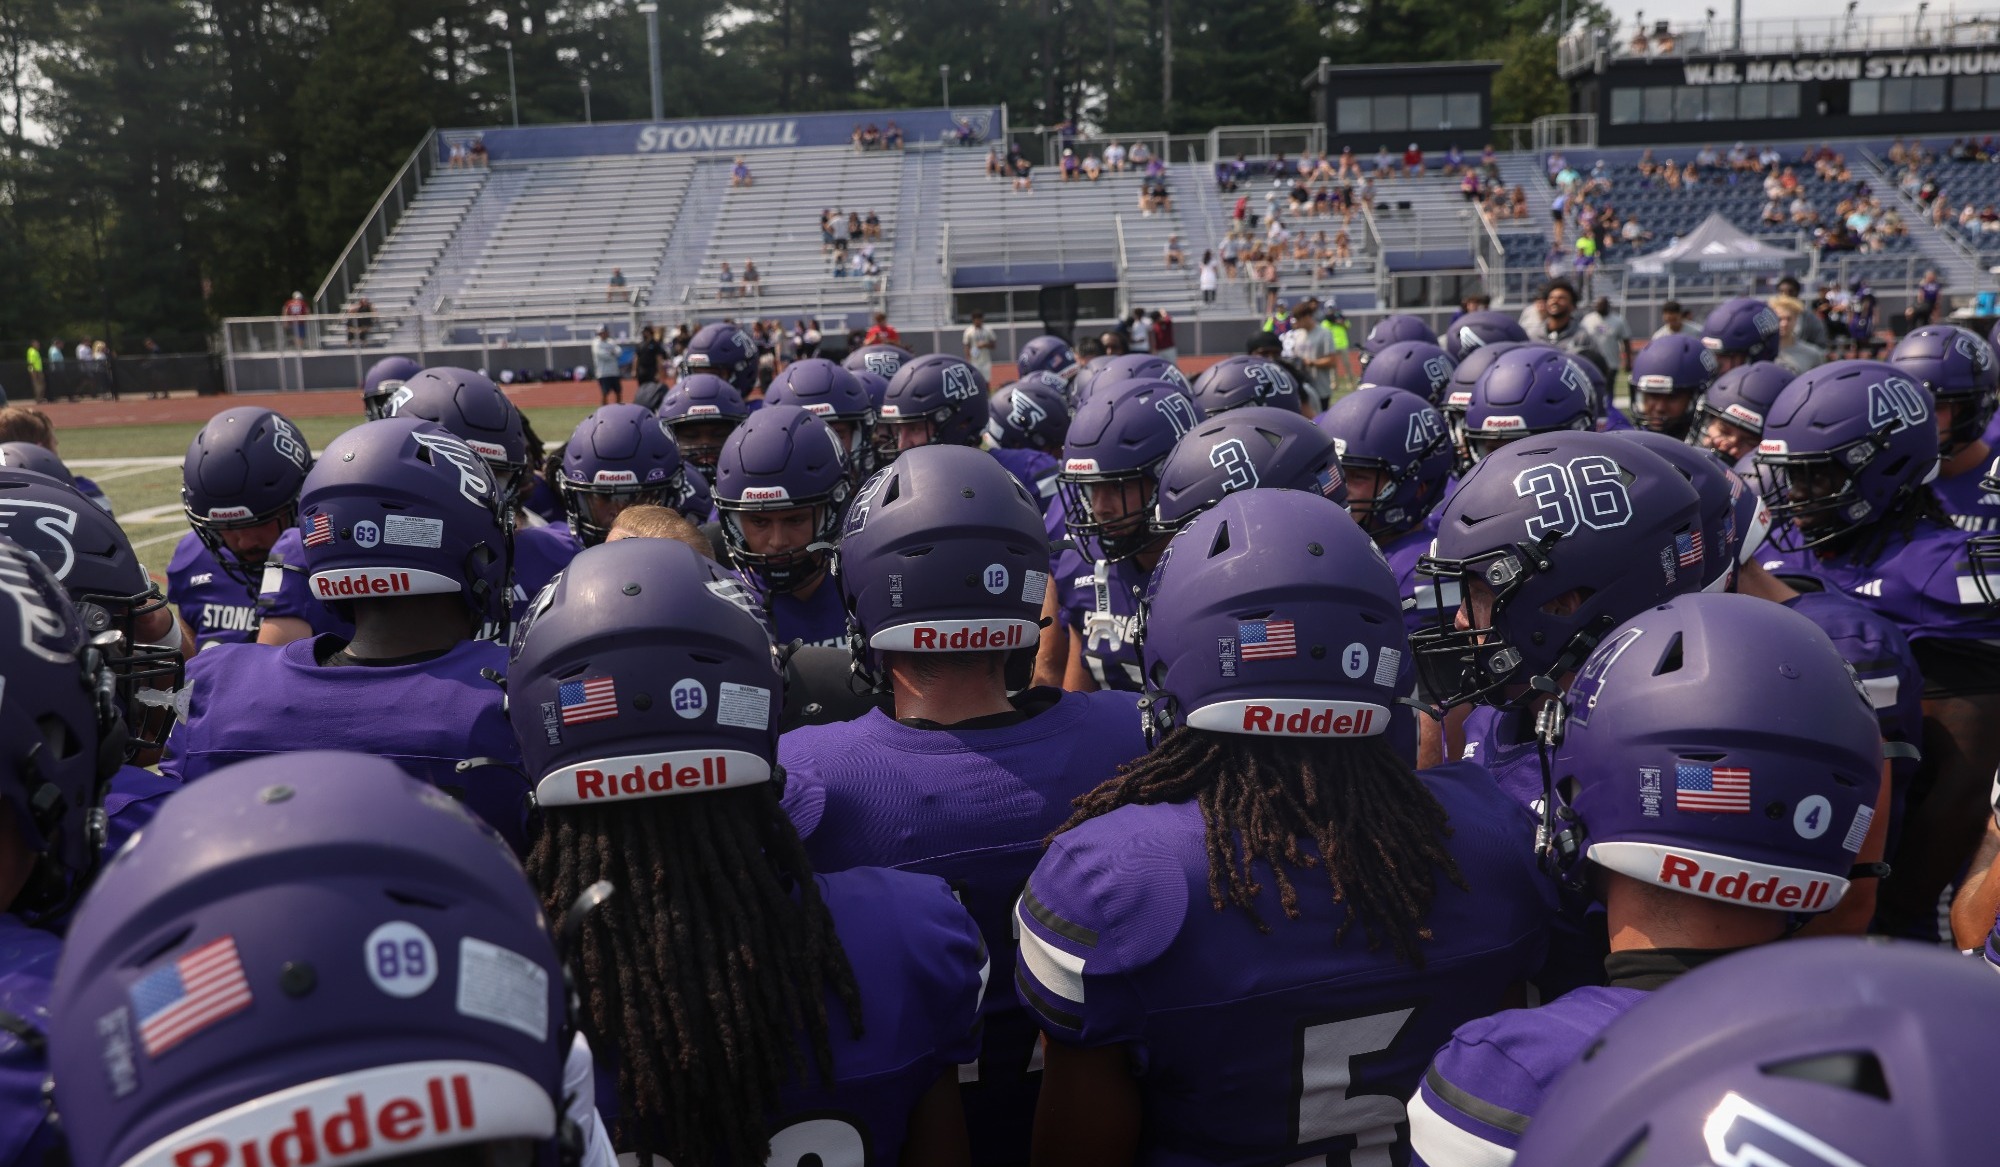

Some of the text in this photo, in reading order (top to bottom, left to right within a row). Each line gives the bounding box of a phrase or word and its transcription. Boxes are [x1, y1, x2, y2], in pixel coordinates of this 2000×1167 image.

[1683, 52, 2000, 85] W.B. MASON STADIUM
[636, 120, 800, 151] STONEHILL
[942, 363, 980, 400] 47
[1244, 362, 1294, 398] 30
[1155, 392, 1199, 442] 17
[1868, 376, 1929, 435] 40
[1486, 419, 1520, 428] Riddell
[599, 473, 632, 482] Riddell
[1208, 437, 1260, 493] 3
[746, 490, 783, 500] Riddell
[1512, 454, 1634, 542] 36
[211, 510, 247, 519] Riddell
[355, 525, 377, 543] 63
[316, 572, 411, 598] Riddell
[987, 570, 1004, 588] 12
[202, 603, 263, 632] STONE
[913, 624, 1023, 650] Riddell
[1350, 650, 1362, 671] 5
[674, 686, 703, 711] 29
[1243, 704, 1374, 735] Riddell
[575, 755, 728, 800] Riddell
[1803, 805, 1822, 831] 4
[1660, 852, 1831, 911] Riddell
[374, 938, 429, 979] 89
[1284, 1006, 1416, 1167] 5
[171, 1073, 477, 1167] Riddell
